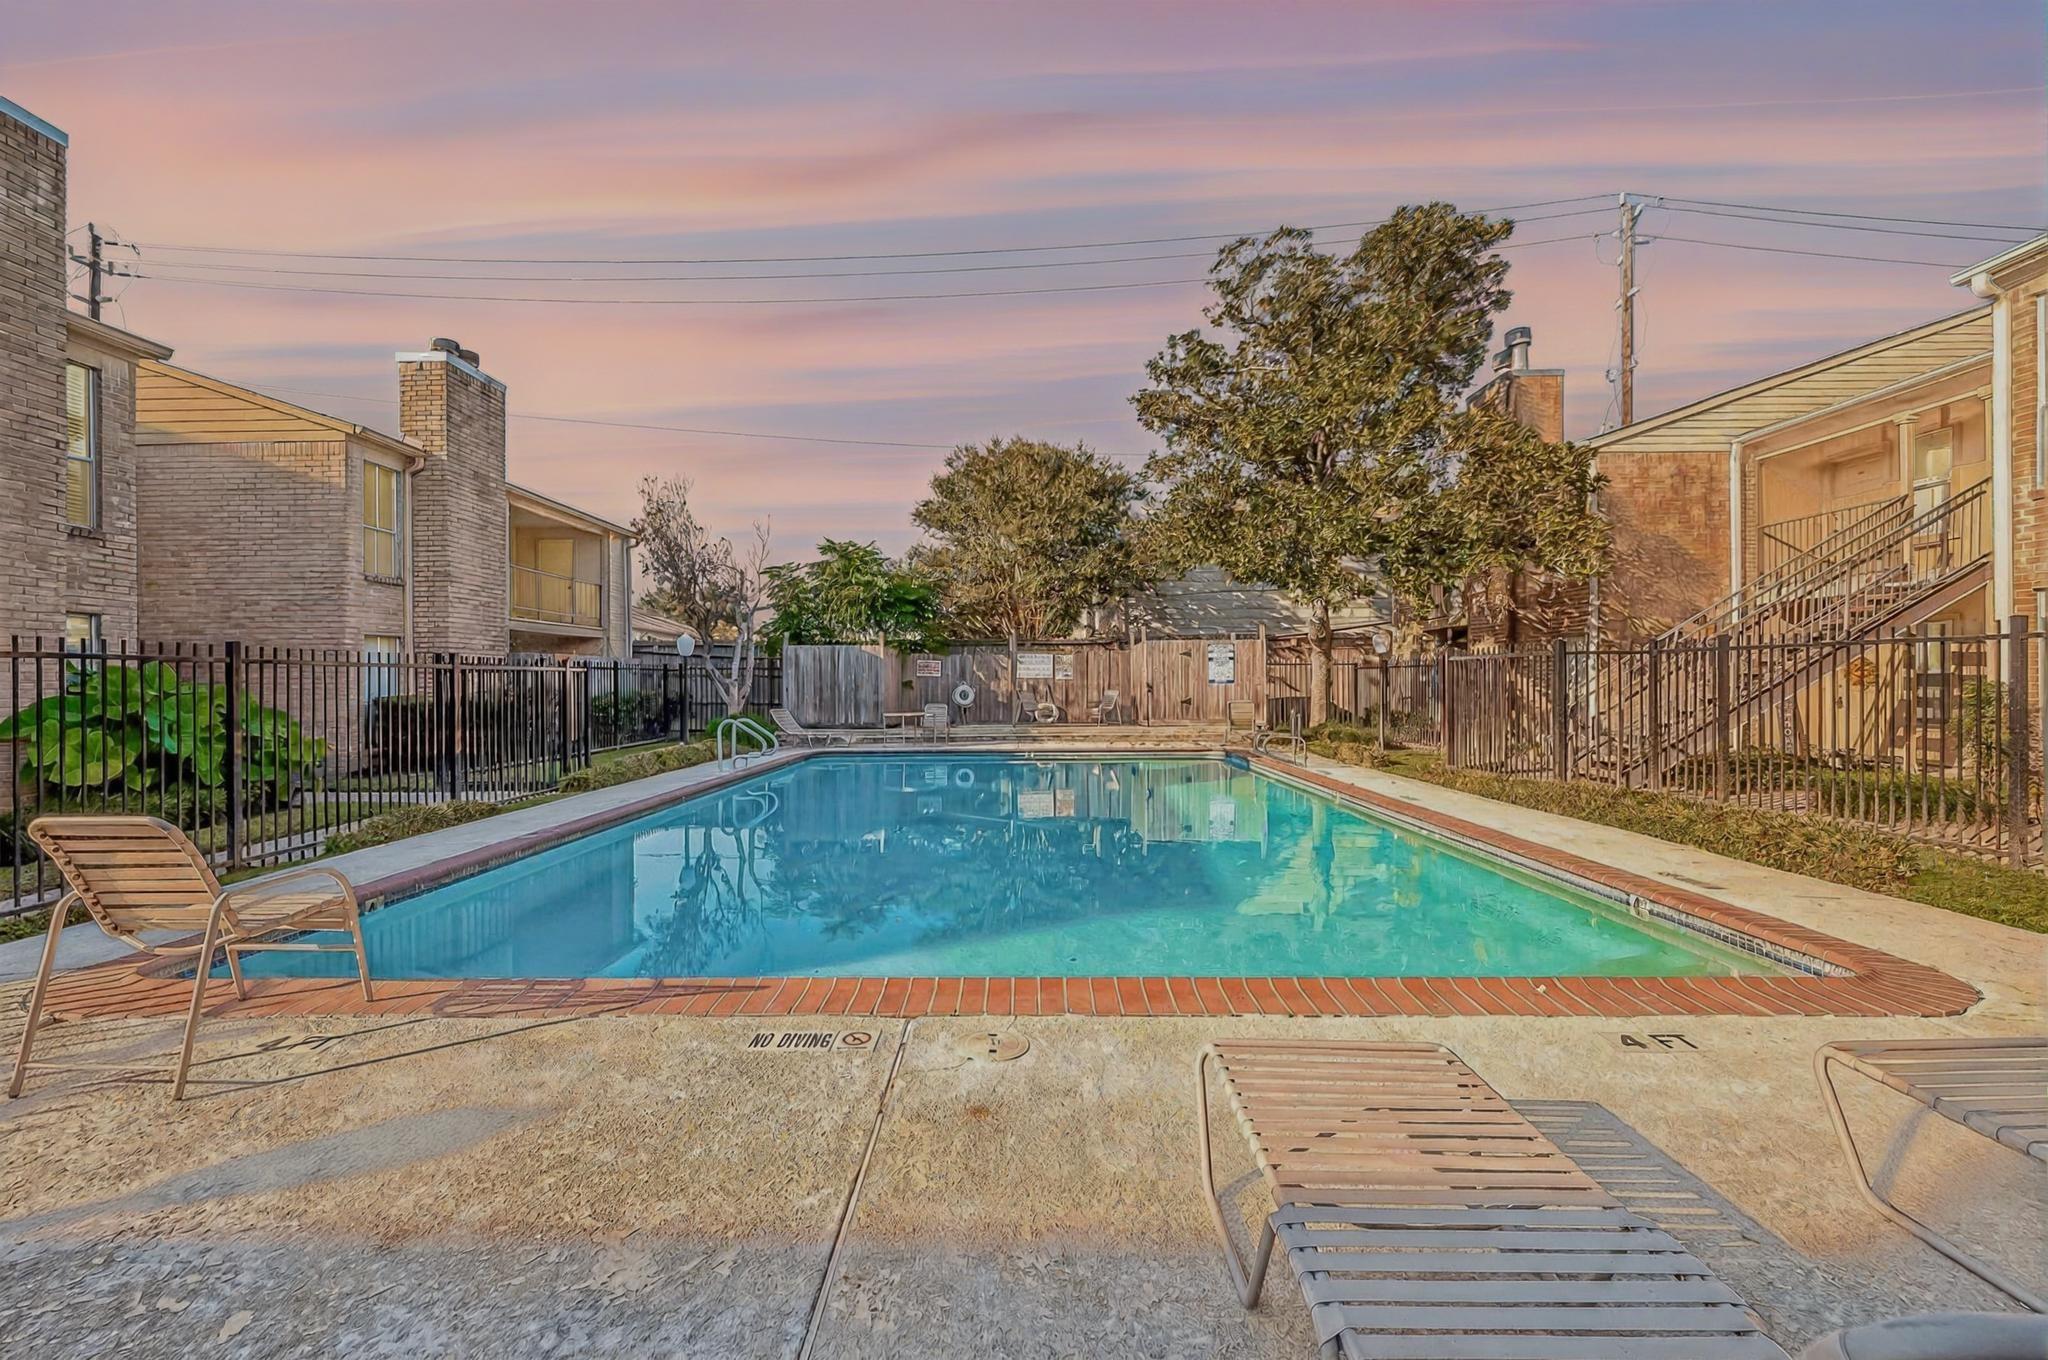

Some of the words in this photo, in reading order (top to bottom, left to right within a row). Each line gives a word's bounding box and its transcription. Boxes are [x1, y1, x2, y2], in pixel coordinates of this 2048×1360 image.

[748, 1033, 775, 1048] NO
[777, 1033, 833, 1048] DIVING
[1620, 1034, 1648, 1049] 4
[1647, 1034, 1699, 1049] FT
